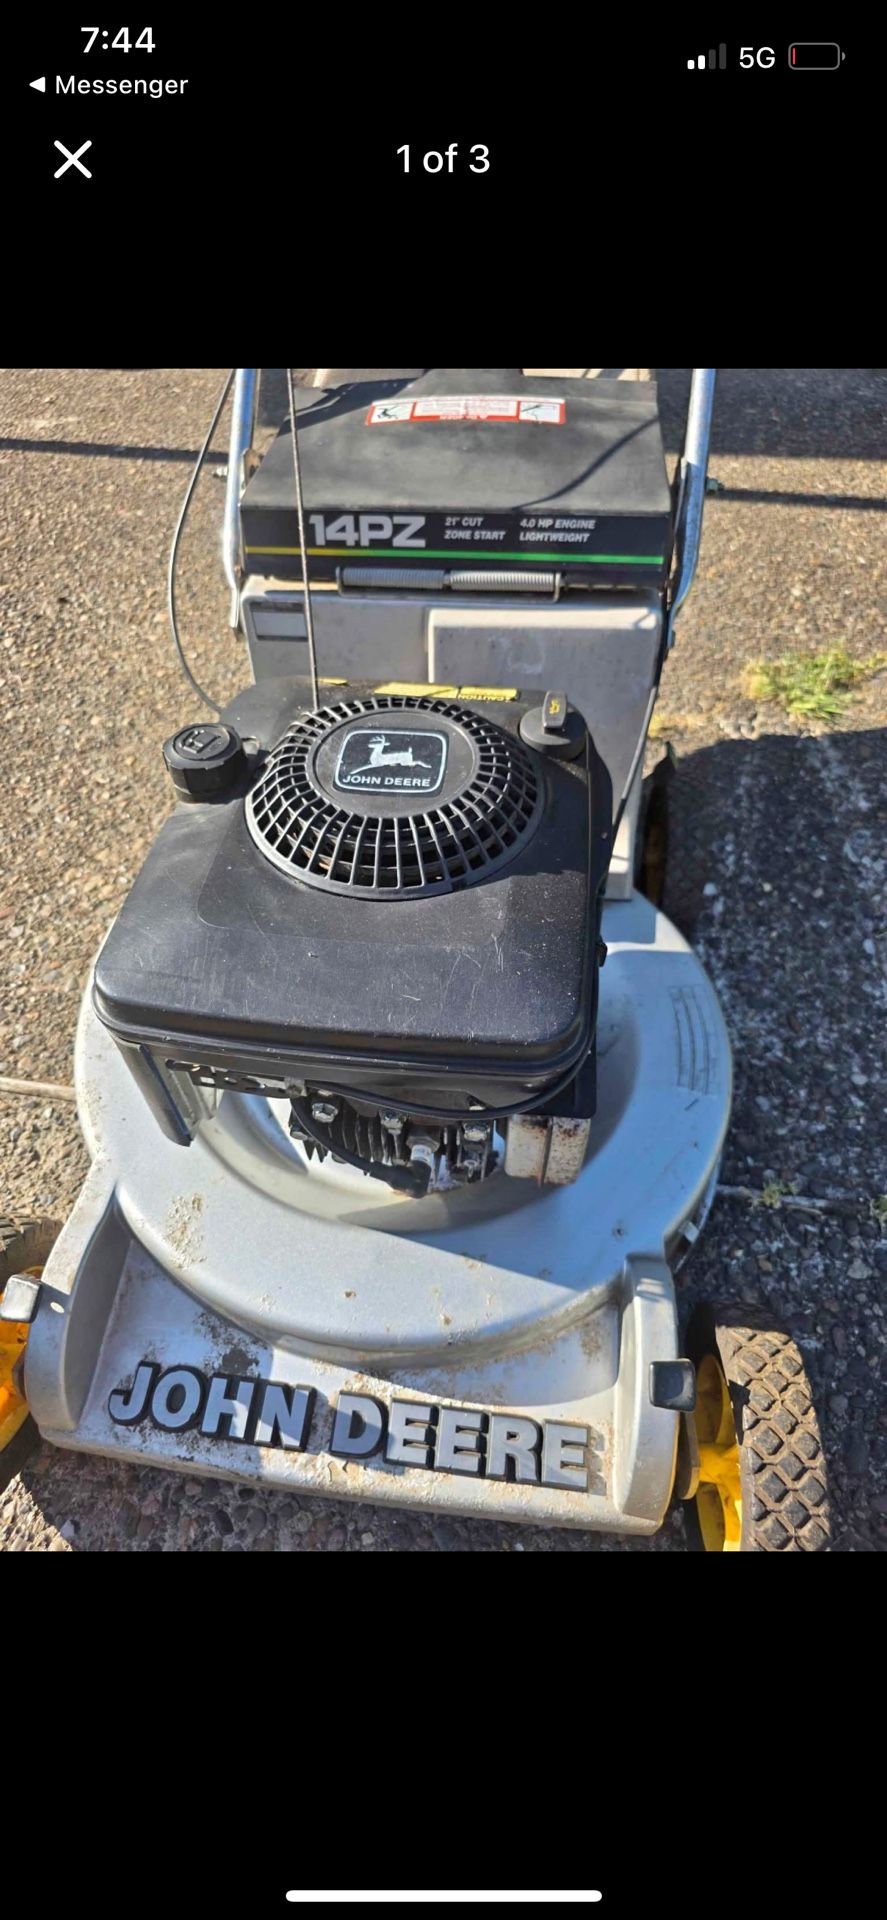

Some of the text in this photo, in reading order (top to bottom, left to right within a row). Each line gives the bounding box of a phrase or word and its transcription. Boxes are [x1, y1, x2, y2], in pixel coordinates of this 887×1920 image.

[461, 517, 484, 527] CUT
[520, 519, 596, 530] 4.0 HP ENGINE
[309, 515, 426, 548] 14PZ
[444, 530, 506, 541] ZONE START
[519, 531, 590, 543] LIGHTWEIGHT
[342, 775, 431, 787] JOHN DEERE
[107, 1360, 591, 1492] JOHN DEERE
